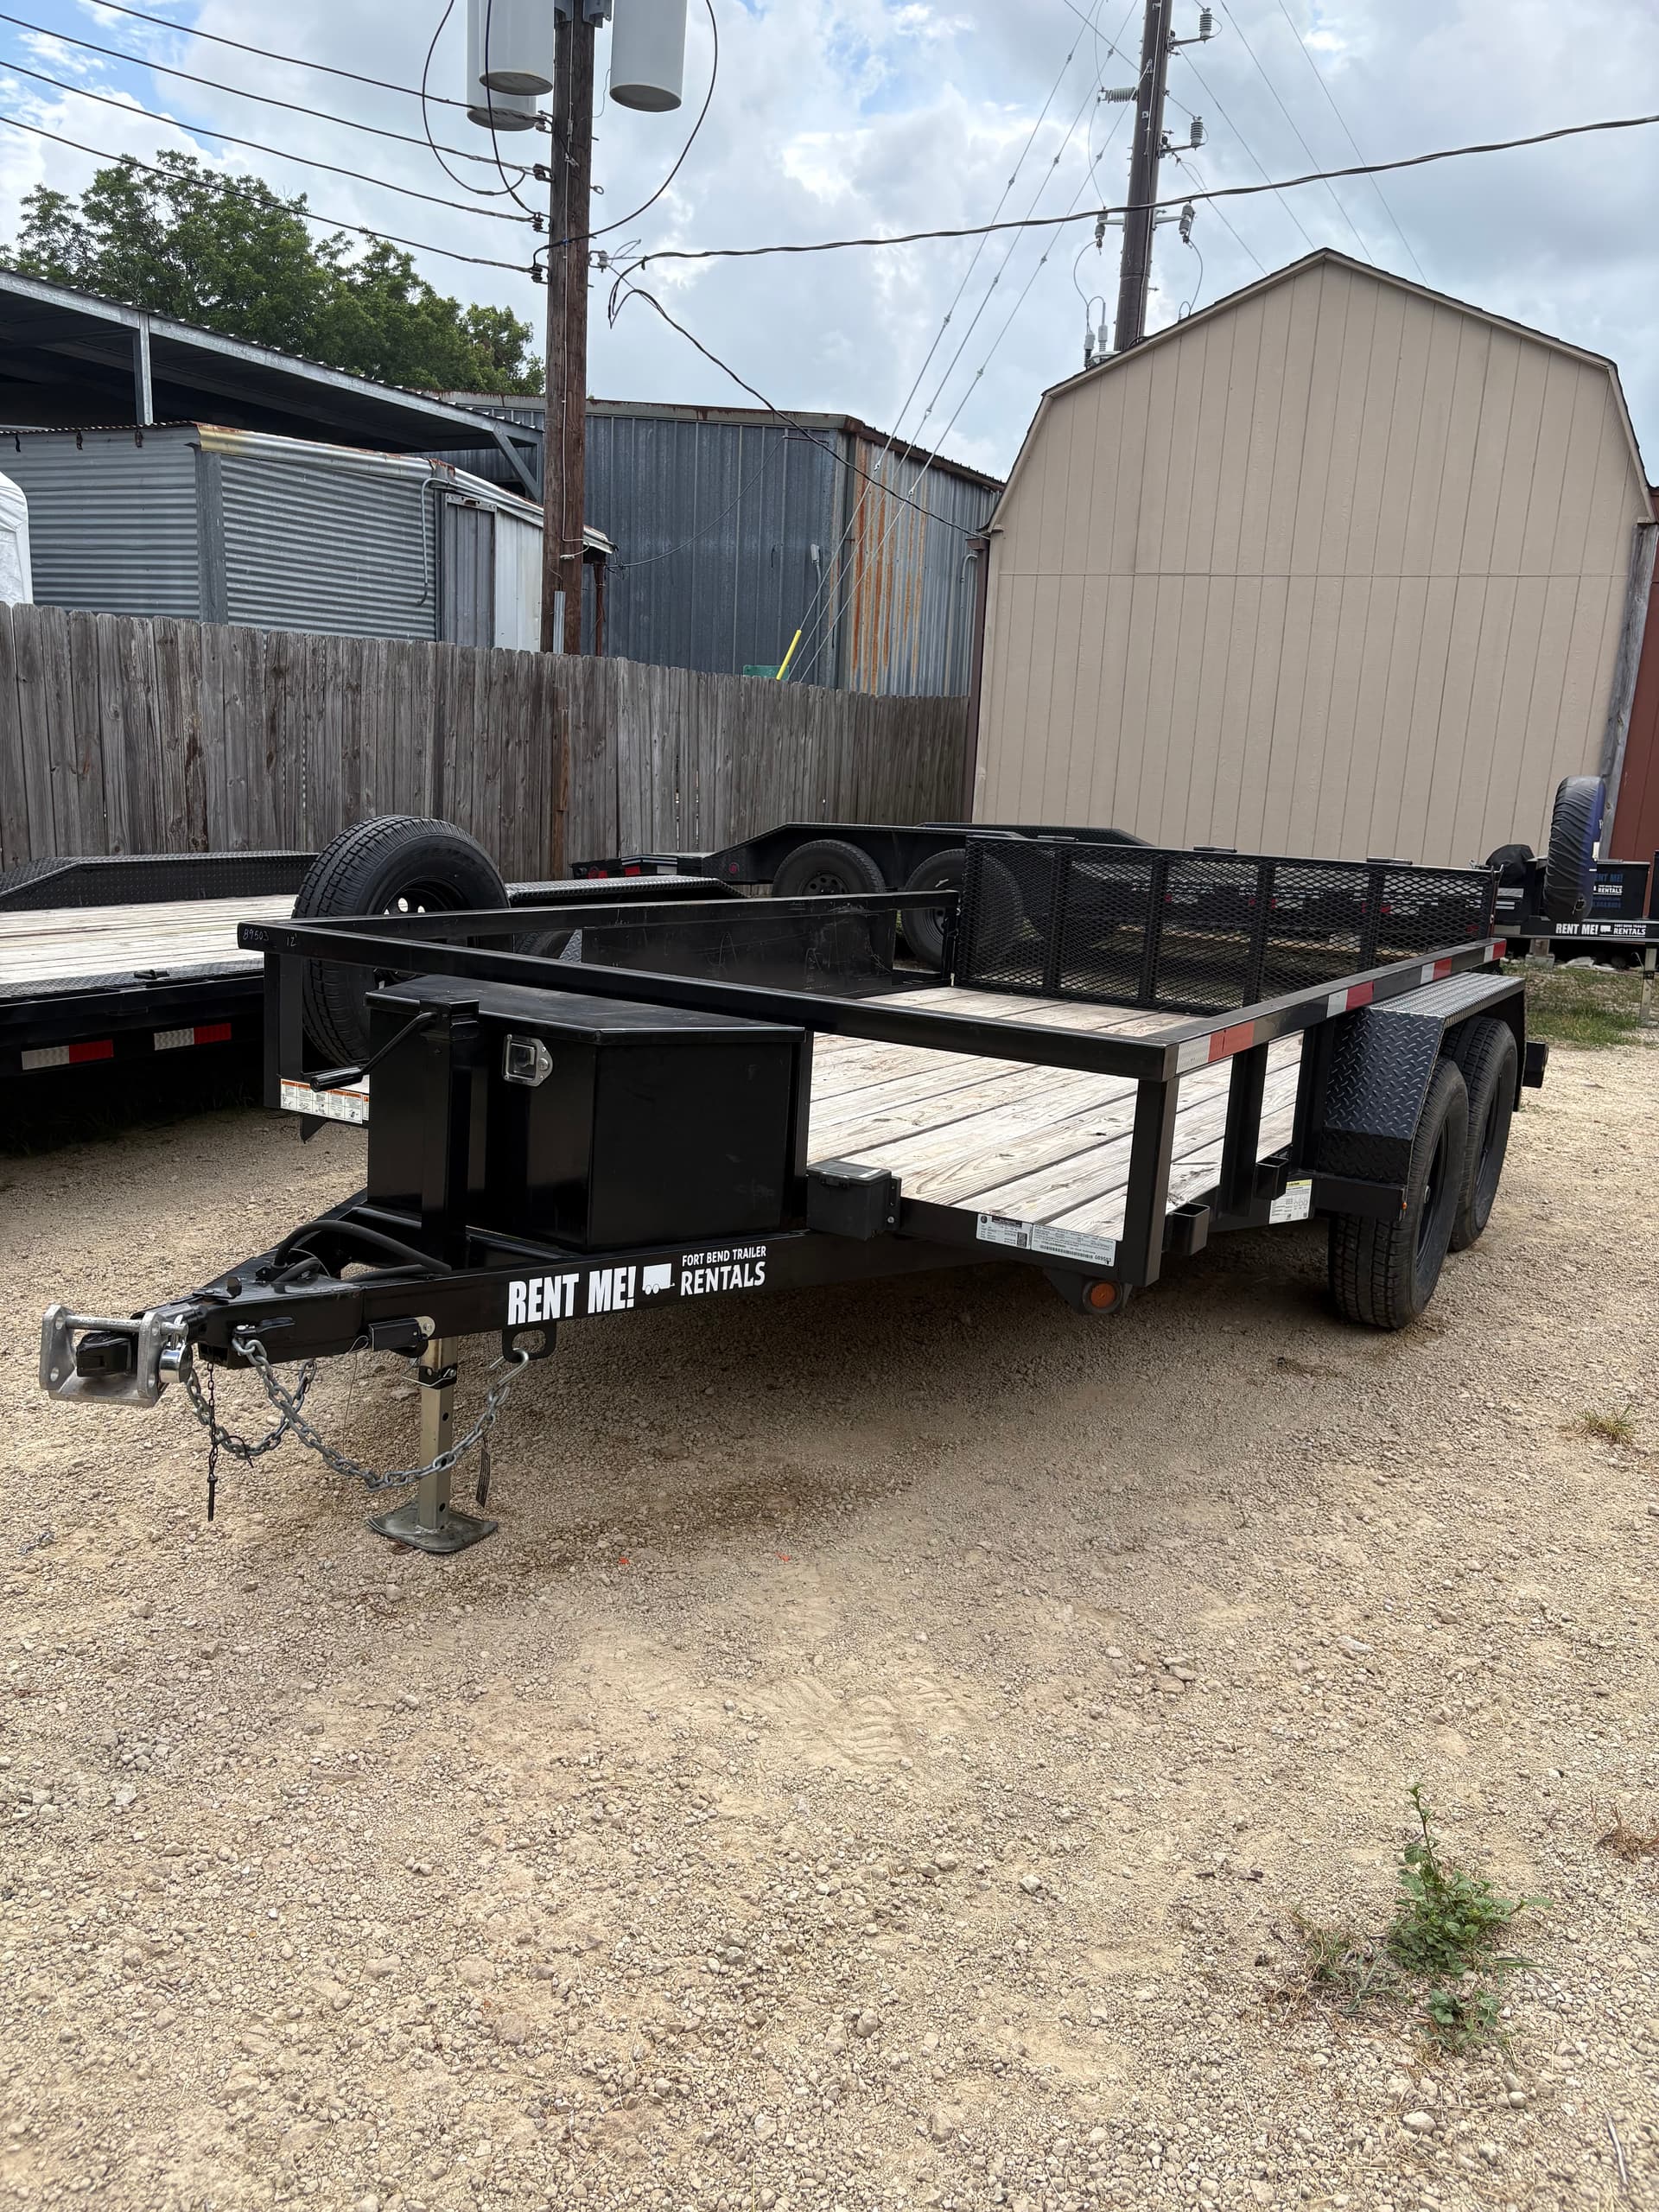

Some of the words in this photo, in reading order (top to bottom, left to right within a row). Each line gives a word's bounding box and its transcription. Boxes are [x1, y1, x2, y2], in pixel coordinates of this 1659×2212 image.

[242, 928, 270, 941] 89503
[1555, 923, 1580, 934] RENT
[1581, 924, 1599, 935] ME!
[682, 1252, 704, 1267] FORT
[706, 1249, 730, 1263] BEND
[732, 1245, 766, 1261] TRAILER
[680, 1261, 766, 1296] RENTALS
[507, 1273, 580, 1325] RENT
[587, 1265, 637, 1314] ME!
